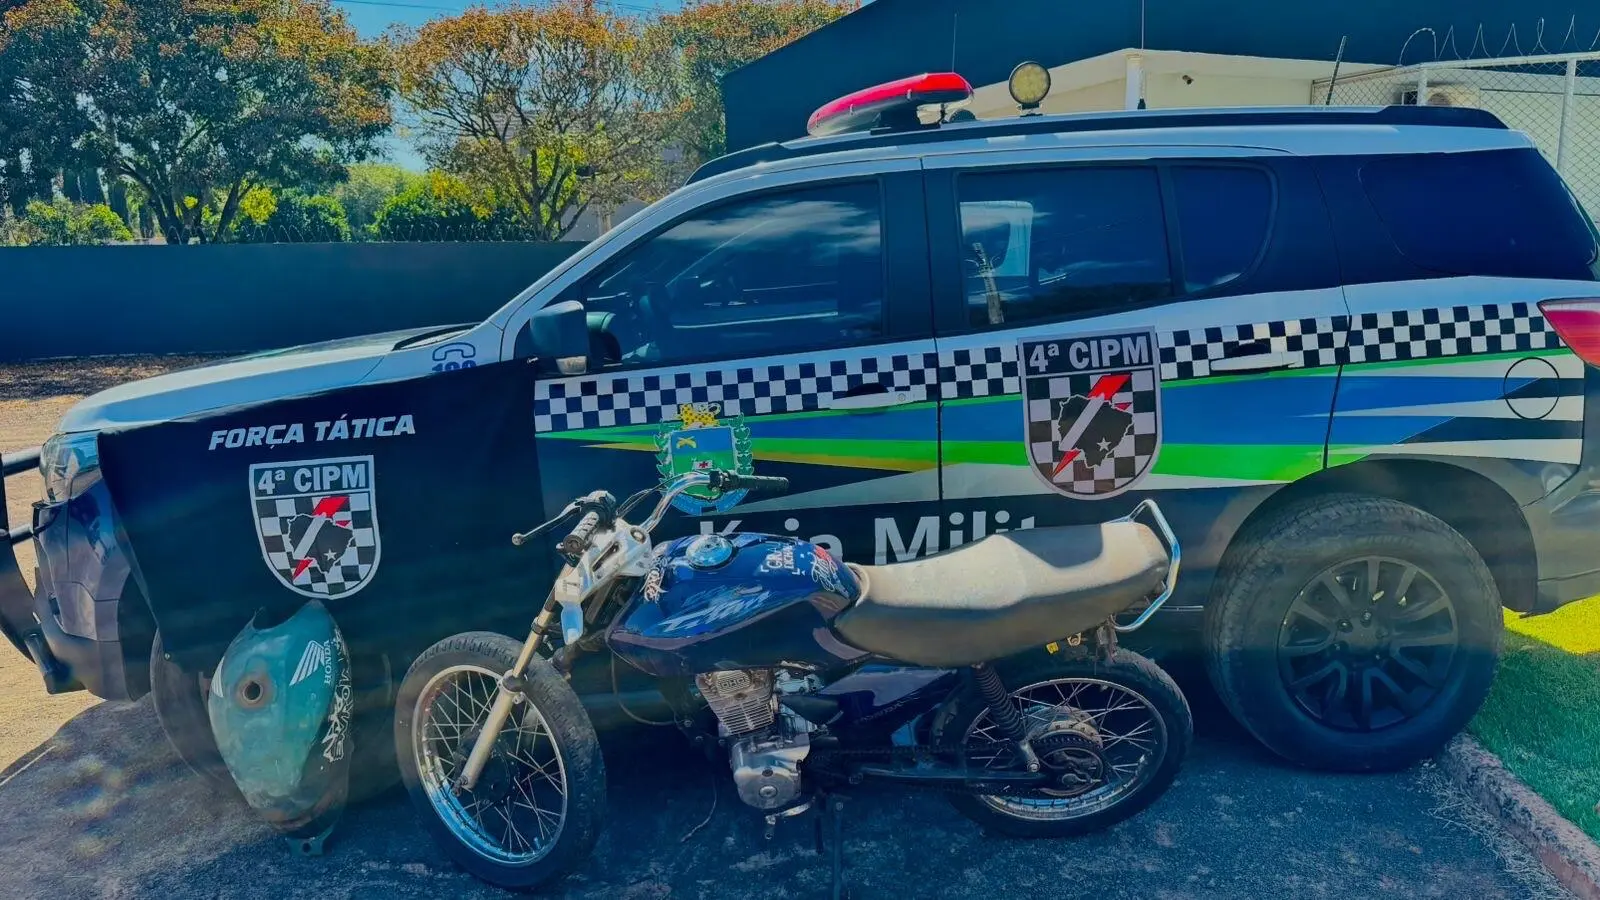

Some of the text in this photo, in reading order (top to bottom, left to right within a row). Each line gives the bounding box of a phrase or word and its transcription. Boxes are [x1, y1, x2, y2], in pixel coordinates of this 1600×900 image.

[1069, 335, 1149, 370] CIPM
[208, 413, 416, 451] FORÇA TÁTICA
[293, 464, 366, 493] CIPM
[323, 640, 332, 686] HONDA
